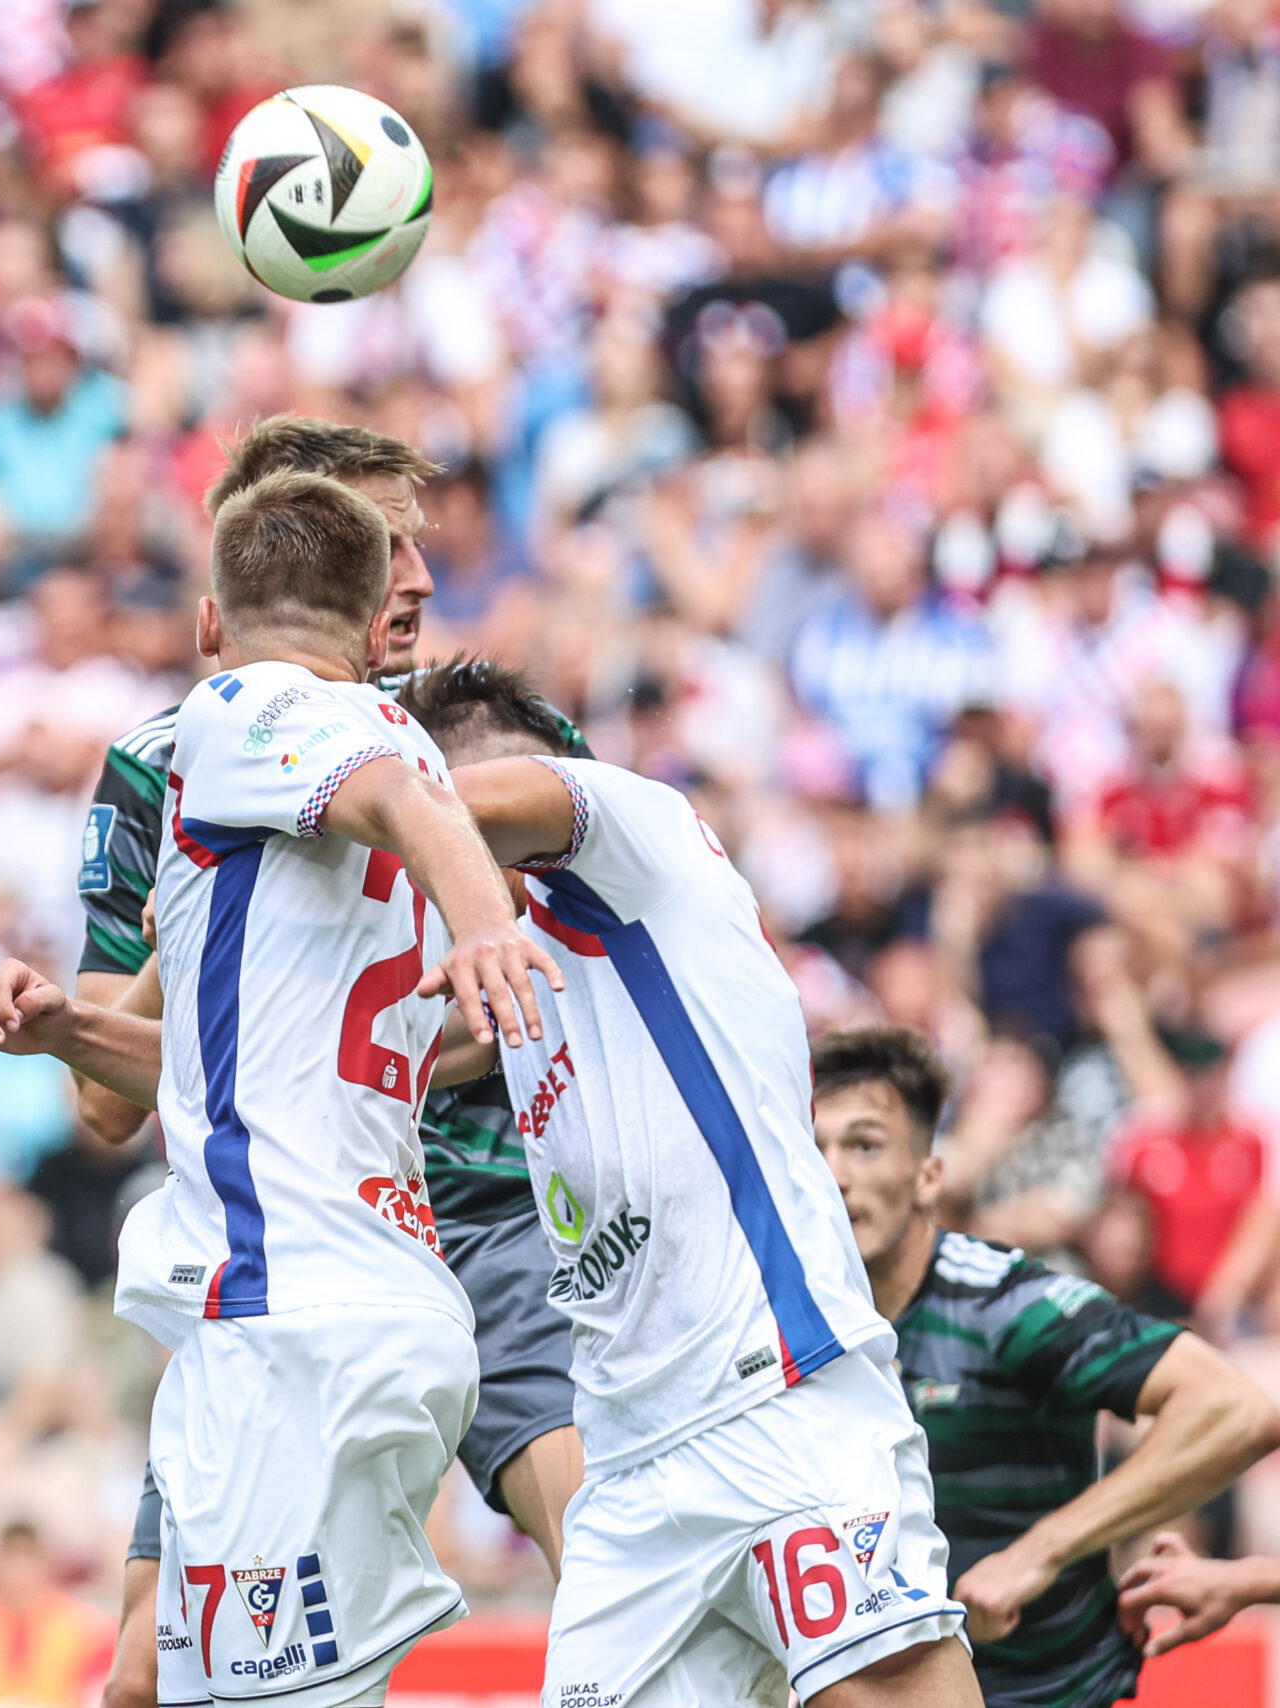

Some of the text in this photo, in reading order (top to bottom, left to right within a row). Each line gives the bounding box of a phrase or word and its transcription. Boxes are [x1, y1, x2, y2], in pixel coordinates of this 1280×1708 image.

[338, 848, 444, 1120] 2
[844, 1512, 887, 1529] ZABRZE
[236, 1569, 282, 1581] ZABRZE
[751, 1526, 847, 1650] 16
[180, 1564, 227, 1679] 7
[157, 1625, 172, 1637] UKAS
[231, 1643, 307, 1679] capelli
[267, 1662, 307, 1680] SPORT
[561, 1683, 598, 1697] LUKAS
